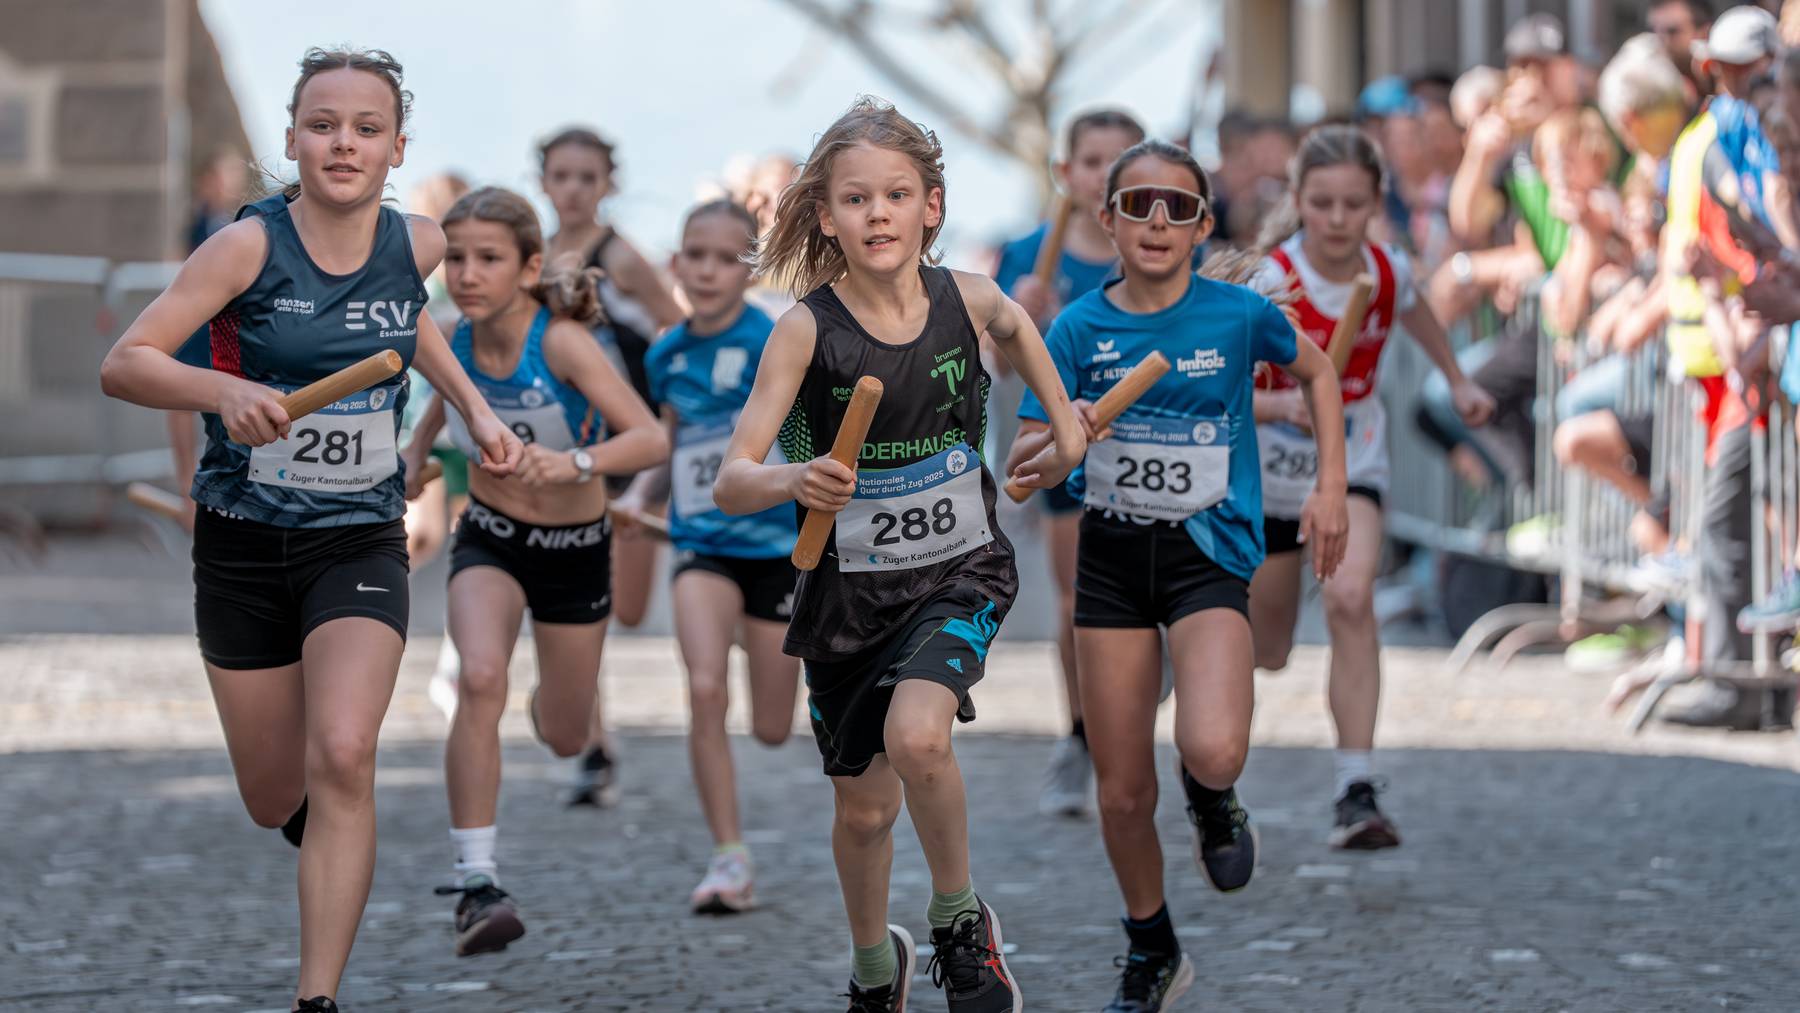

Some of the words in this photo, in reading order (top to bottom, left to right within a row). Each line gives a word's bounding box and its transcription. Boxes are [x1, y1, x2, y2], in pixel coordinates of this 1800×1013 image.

[345, 300, 411, 330] ESV
[935, 346, 962, 363] brunnen
[334, 401, 350, 412] Zug
[350, 400, 368, 410] 2025
[291, 427, 364, 467] 281
[290, 472, 317, 485] Zuger
[318, 475, 374, 486] Kantonalbank
[859, 475, 905, 486] Nationales
[860, 486, 881, 496] Quer
[882, 484, 907, 494] durch
[908, 478, 924, 489] Zug
[924, 470, 945, 484] 2025
[1115, 455, 1192, 494] 283
[870, 497, 957, 547] 288
[525, 526, 603, 551] NIKE
[882, 554, 909, 566] Zuger
[910, 537, 968, 562] Kantonalbank
